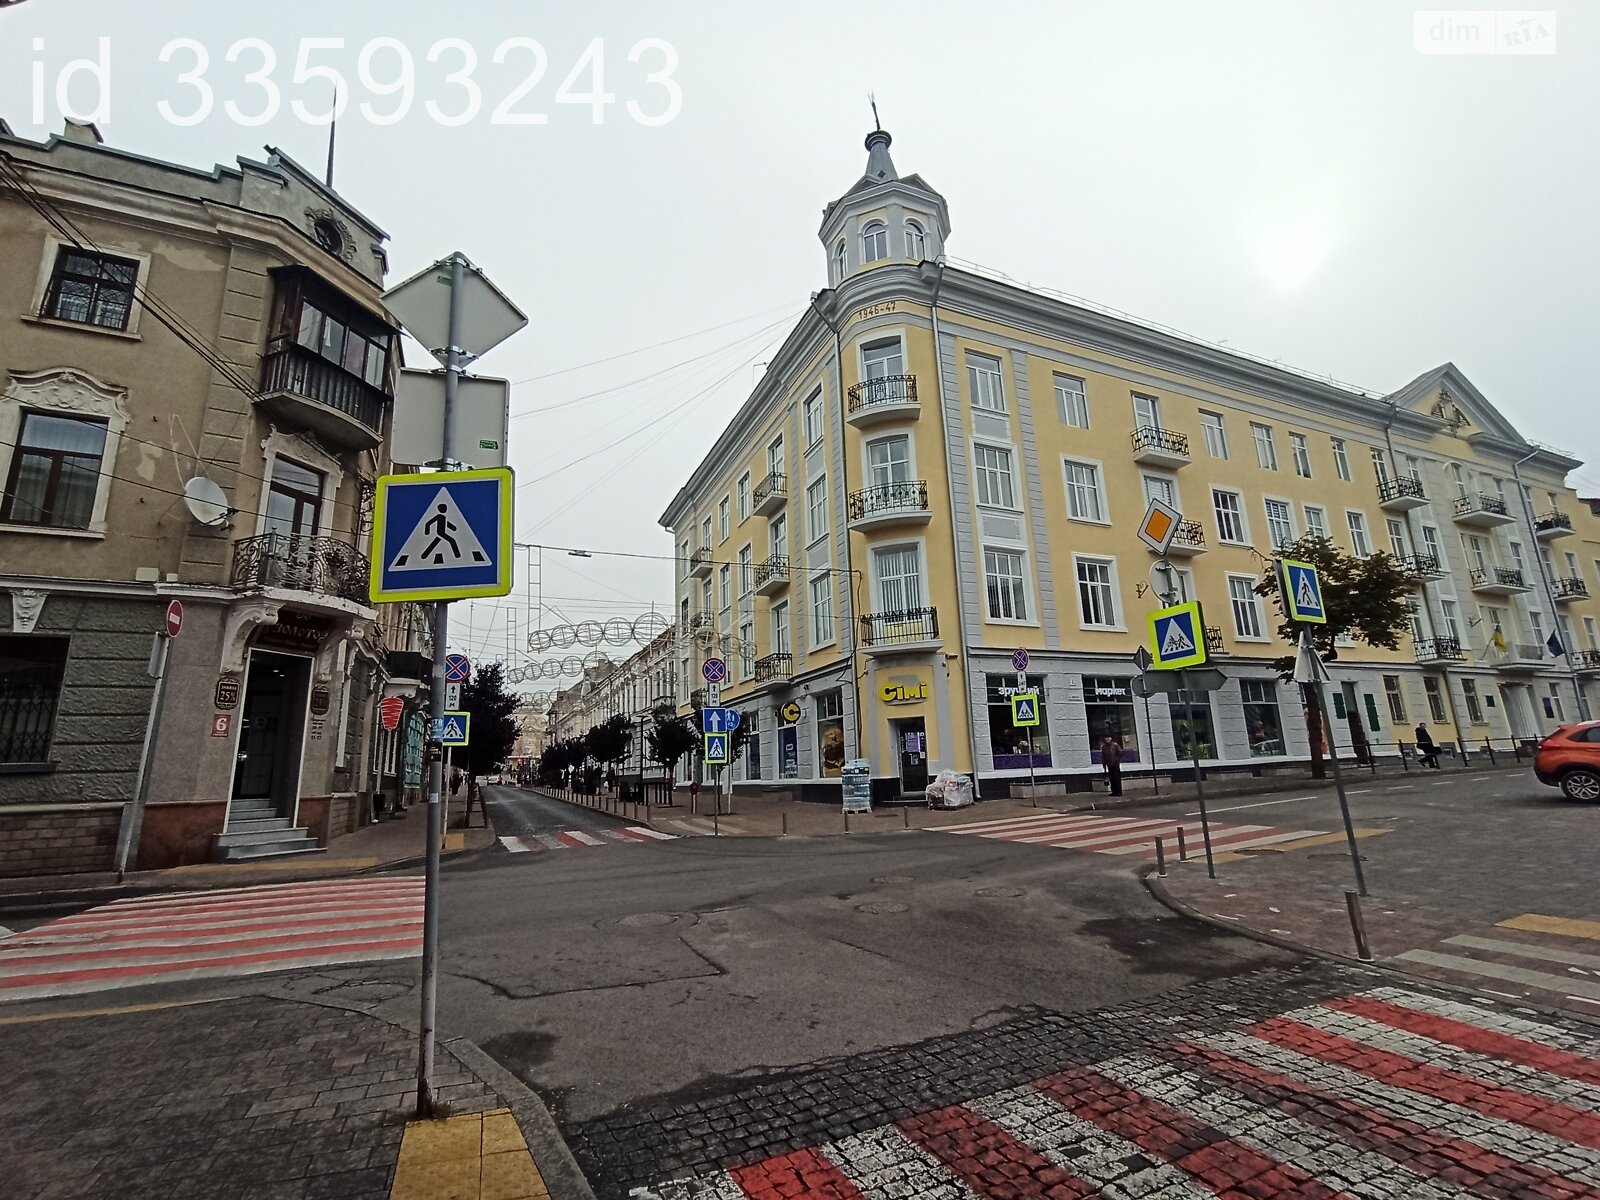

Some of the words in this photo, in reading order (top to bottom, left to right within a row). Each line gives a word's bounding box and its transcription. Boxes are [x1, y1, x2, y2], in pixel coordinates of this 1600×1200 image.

[858, 301, 896, 320] 1946-47
[219, 691, 236, 701] 25%
[998, 685, 1040, 697] зручий
[1095, 687, 1126, 696] маркет
[216, 717, 227, 731] 6
